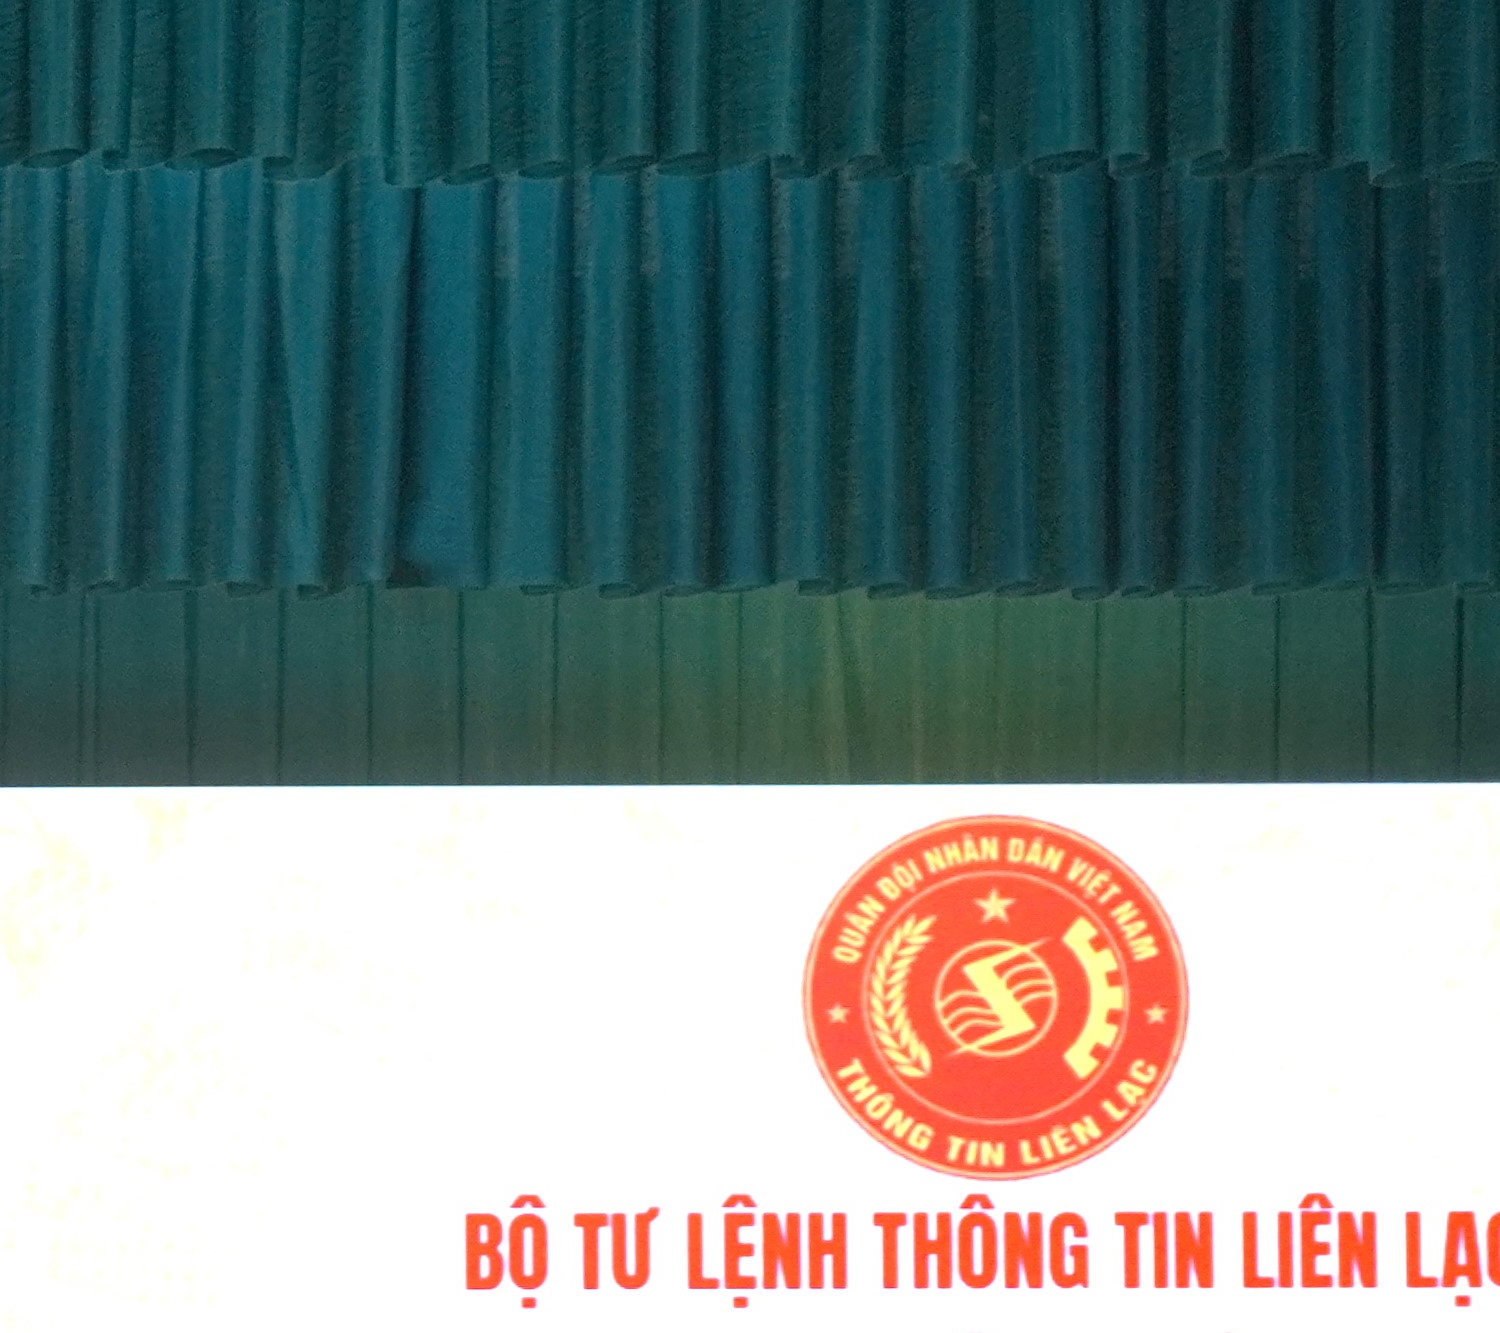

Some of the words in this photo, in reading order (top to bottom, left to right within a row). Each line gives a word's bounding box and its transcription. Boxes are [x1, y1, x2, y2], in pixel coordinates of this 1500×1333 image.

[832, 893, 886, 963] QUÂN
[876, 858, 923, 901] ĐỘI
[923, 833, 999, 873] NHÂN
[1007, 836, 1066, 873] DÂN
[1066, 856, 1122, 903] VIỆT
[1110, 900, 1159, 961] NAM
[837, 1057, 935, 1151] THÔNG
[947, 1136, 1006, 1167] TIN
[1014, 1115, 1102, 1165] LIÊN
[1101, 1059, 1158, 1121] LẠC
[465, 1195, 548, 1309] BỘ
[574, 1207, 659, 1290] TƯ
[687, 1194, 847, 1309] LỆNH
[873, 1194, 1088, 1290] THÔNG
[1114, 1211, 1213, 1290] TIN
[1242, 1193, 1377, 1289] LIÊN
